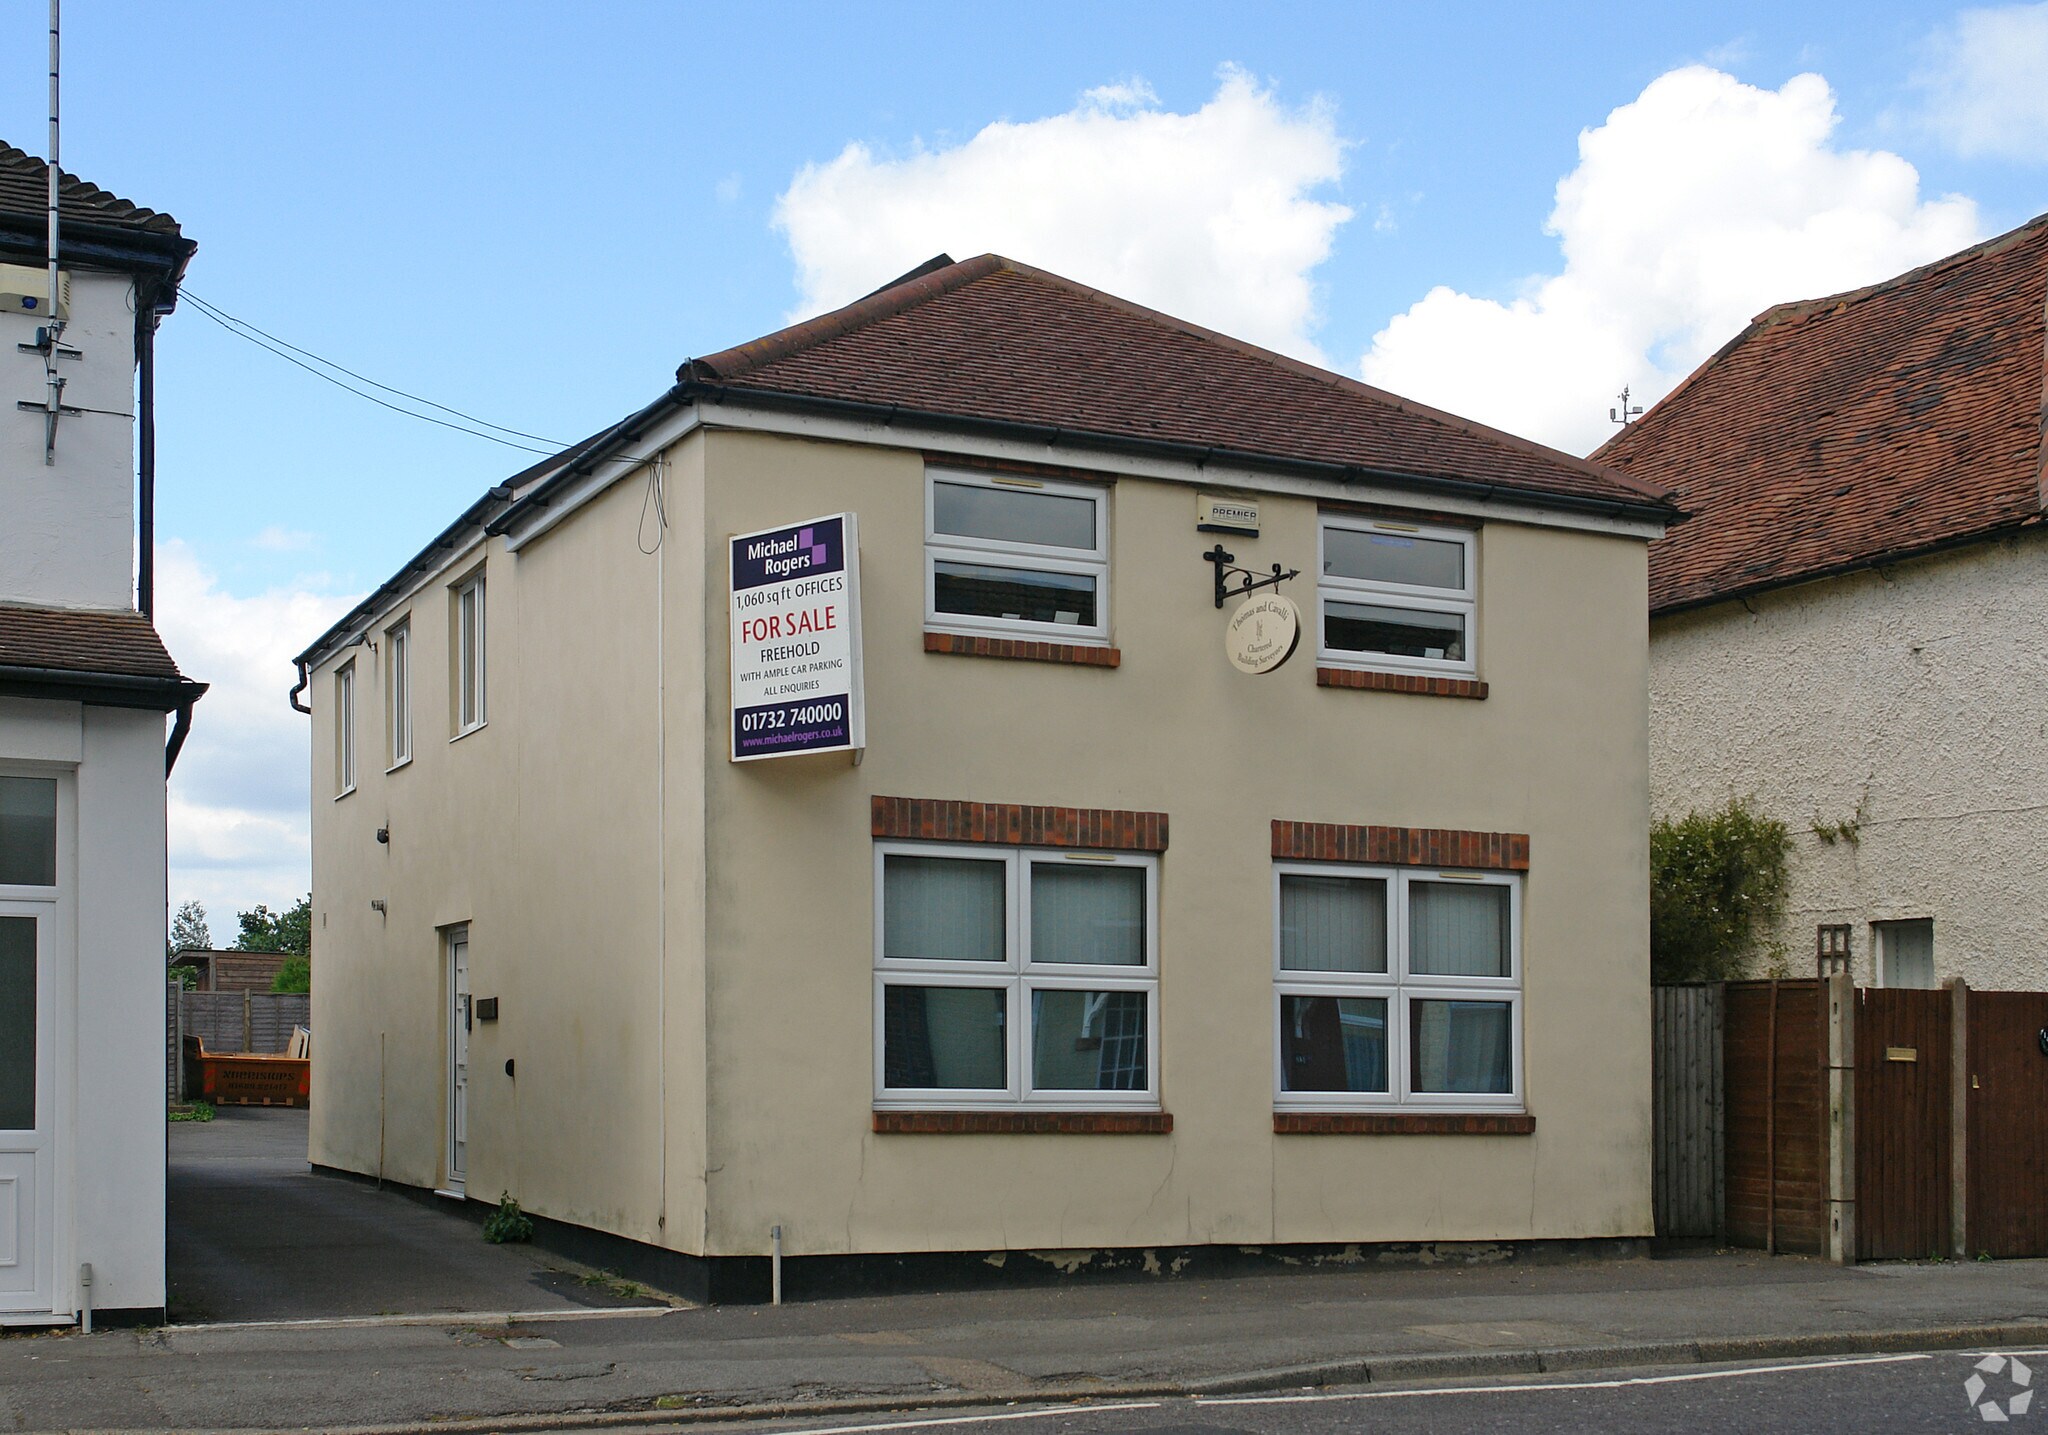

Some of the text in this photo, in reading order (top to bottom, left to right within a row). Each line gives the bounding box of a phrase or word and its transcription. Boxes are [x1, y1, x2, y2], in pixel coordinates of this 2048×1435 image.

[748, 534, 797, 560] Michael
[765, 554, 810, 576] Rogers
[736, 577, 843, 611] 1,060 sq ft OFFICES
[742, 605, 836, 644] FOR SALE
[1232, 608, 1255, 631] Thomas
[1256, 601, 1267, 613] and
[761, 641, 820, 663] FREEHOLD
[1237, 645, 1283, 668] Building Surveyors
[1247, 639, 1272, 653] Chartered
[740, 658, 843, 682] WITH AMPLE CAR PARKING
[763, 680, 820, 696] ALL ENQUIRIES
[742, 702, 842, 732] 01732 740000
[742, 725, 843, 747] www.michaelrogers.co.uk
